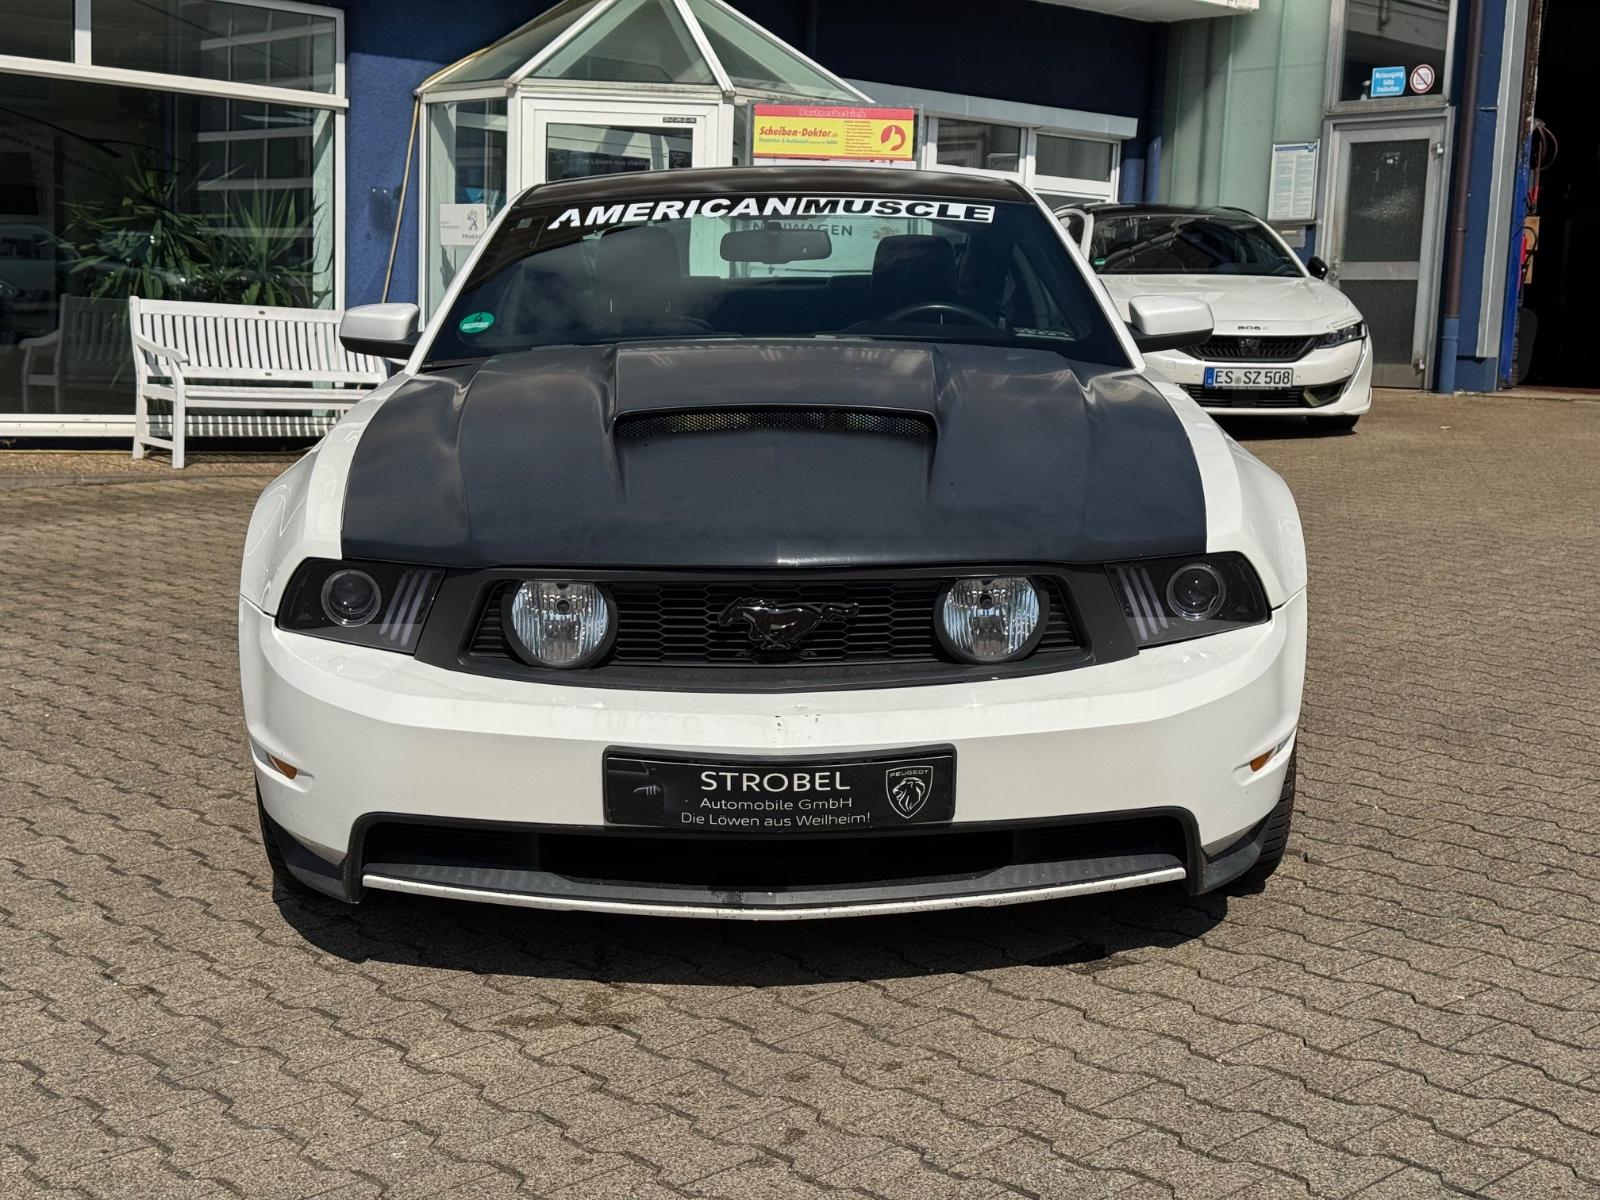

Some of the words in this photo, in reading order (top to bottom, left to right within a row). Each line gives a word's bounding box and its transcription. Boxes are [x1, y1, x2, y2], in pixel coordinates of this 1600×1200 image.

[1214, 370, 1234, 384] ES
[1243, 370, 1262, 384] SZ
[1264, 370, 1290, 384] 508
[700, 771, 850, 792] STROBEL
[700, 798, 793, 811] Automobile
[798, 797, 852, 810] GmbH
[681, 812, 705, 825] Die
[709, 814, 760, 827] Löwen
[764, 817, 792, 827] aus
[796, 812, 870, 826] Weilheim!
